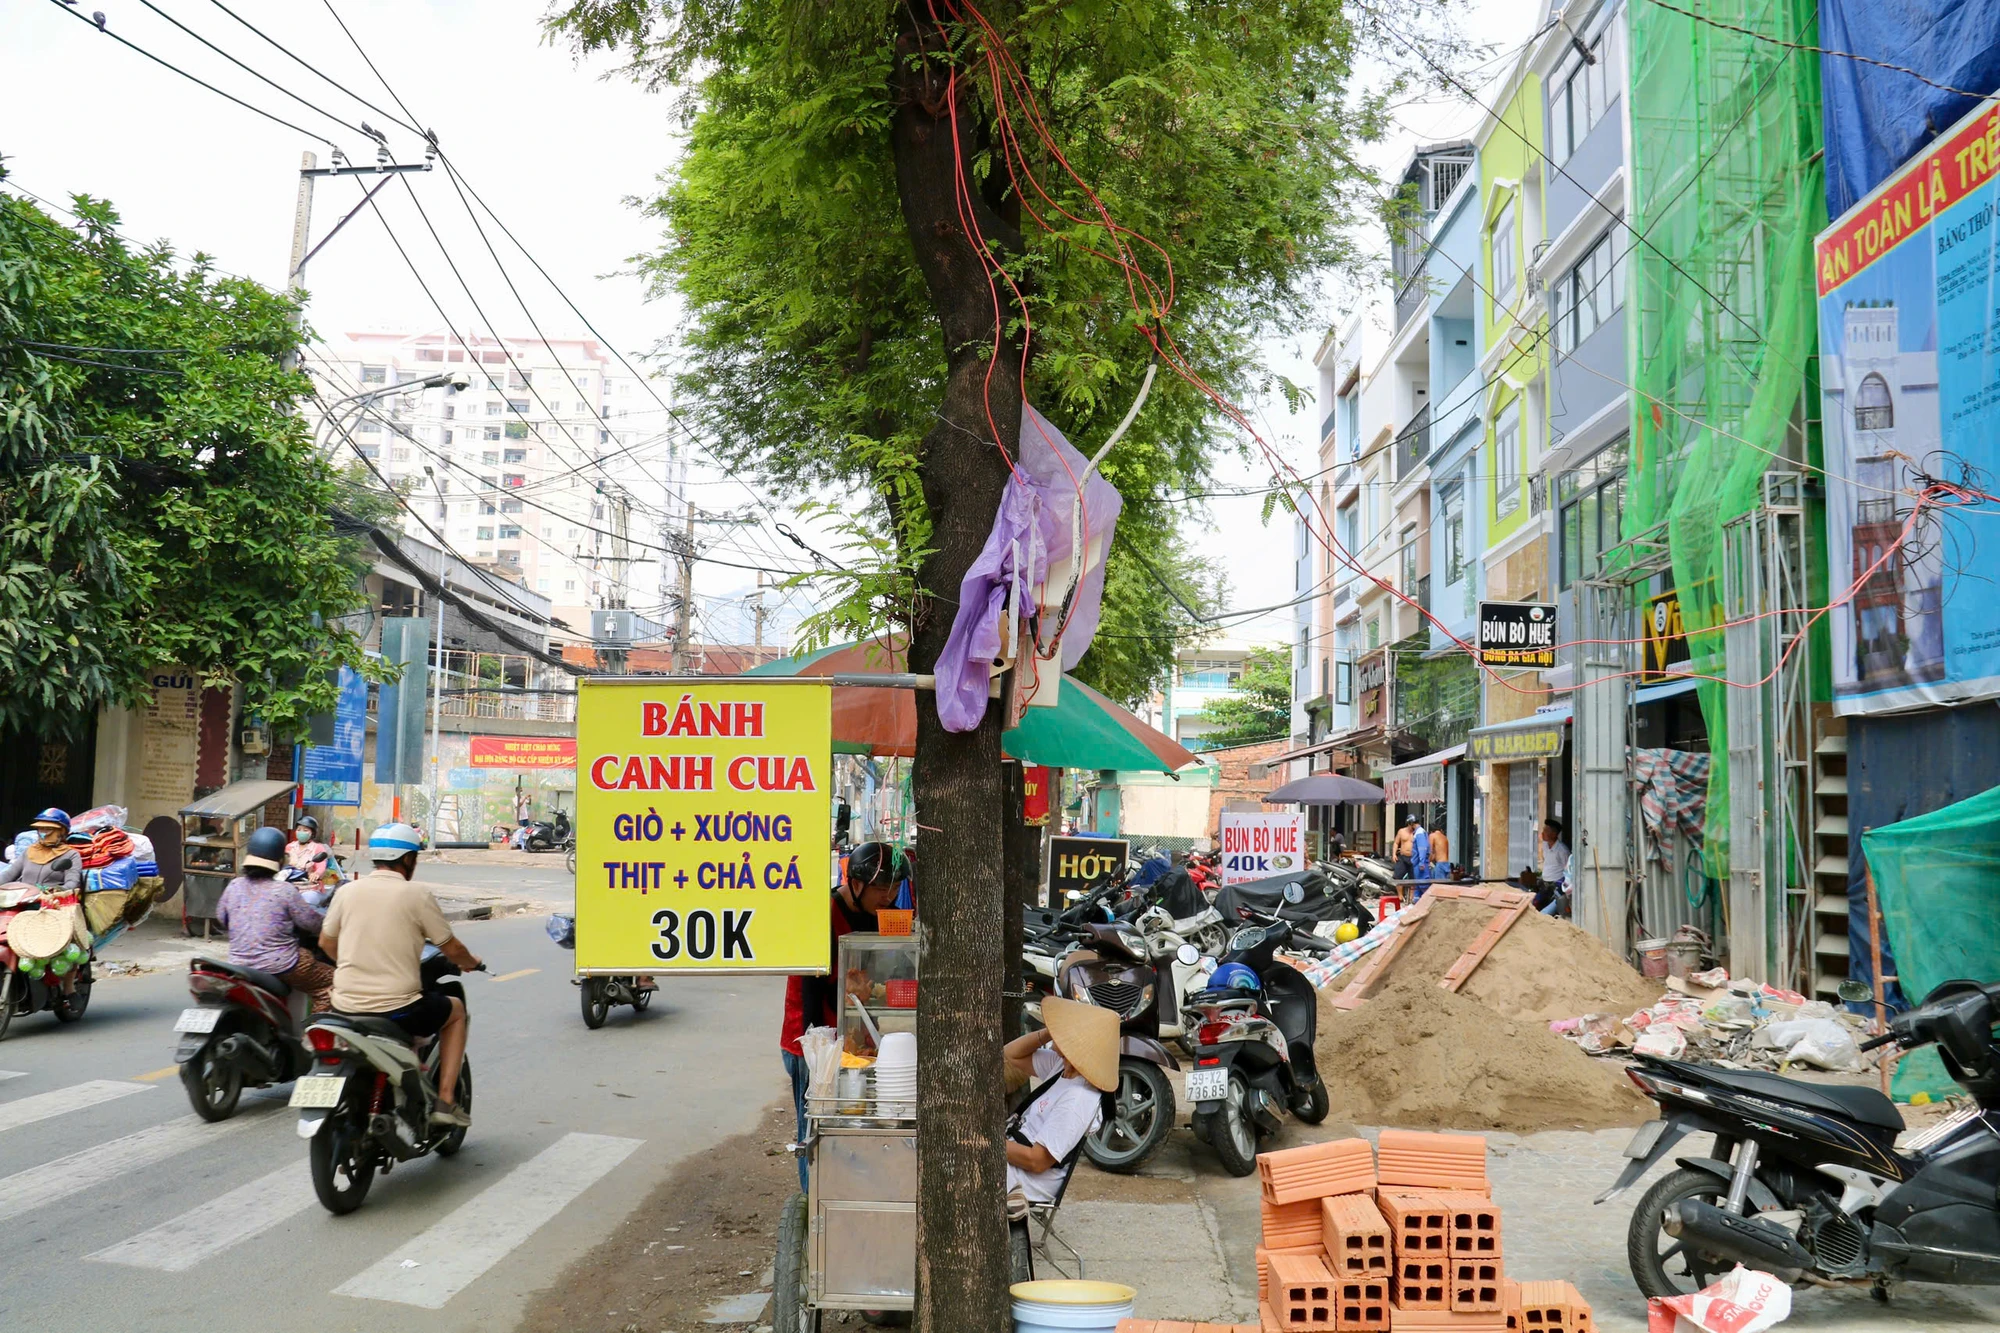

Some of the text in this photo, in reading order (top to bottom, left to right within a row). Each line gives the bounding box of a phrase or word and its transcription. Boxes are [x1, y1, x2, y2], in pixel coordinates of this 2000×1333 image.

[1822, 240, 1849, 283] AN
[1482, 614, 1554, 645] BÚN BÒ HUẾ
[642, 694, 764, 738] BÁNH
[1494, 730, 1559, 755] BARBER
[591, 755, 815, 791] CANH CUA
[614, 806, 793, 842] GIÒ + XƯƠNG
[1225, 816, 1299, 853] BÚN BÒ HUẾ
[603, 851, 803, 895] THỊT + CHẢ CÁ
[1058, 848, 1117, 880] HỚT
[1226, 855, 1270, 872] 40k
[651, 909, 754, 960] 30K
[1188, 1084, 1226, 1100] 736.85
[1192, 1071, 1222, 1086] 59-X2
[1754, 1283, 1773, 1304] SCG
